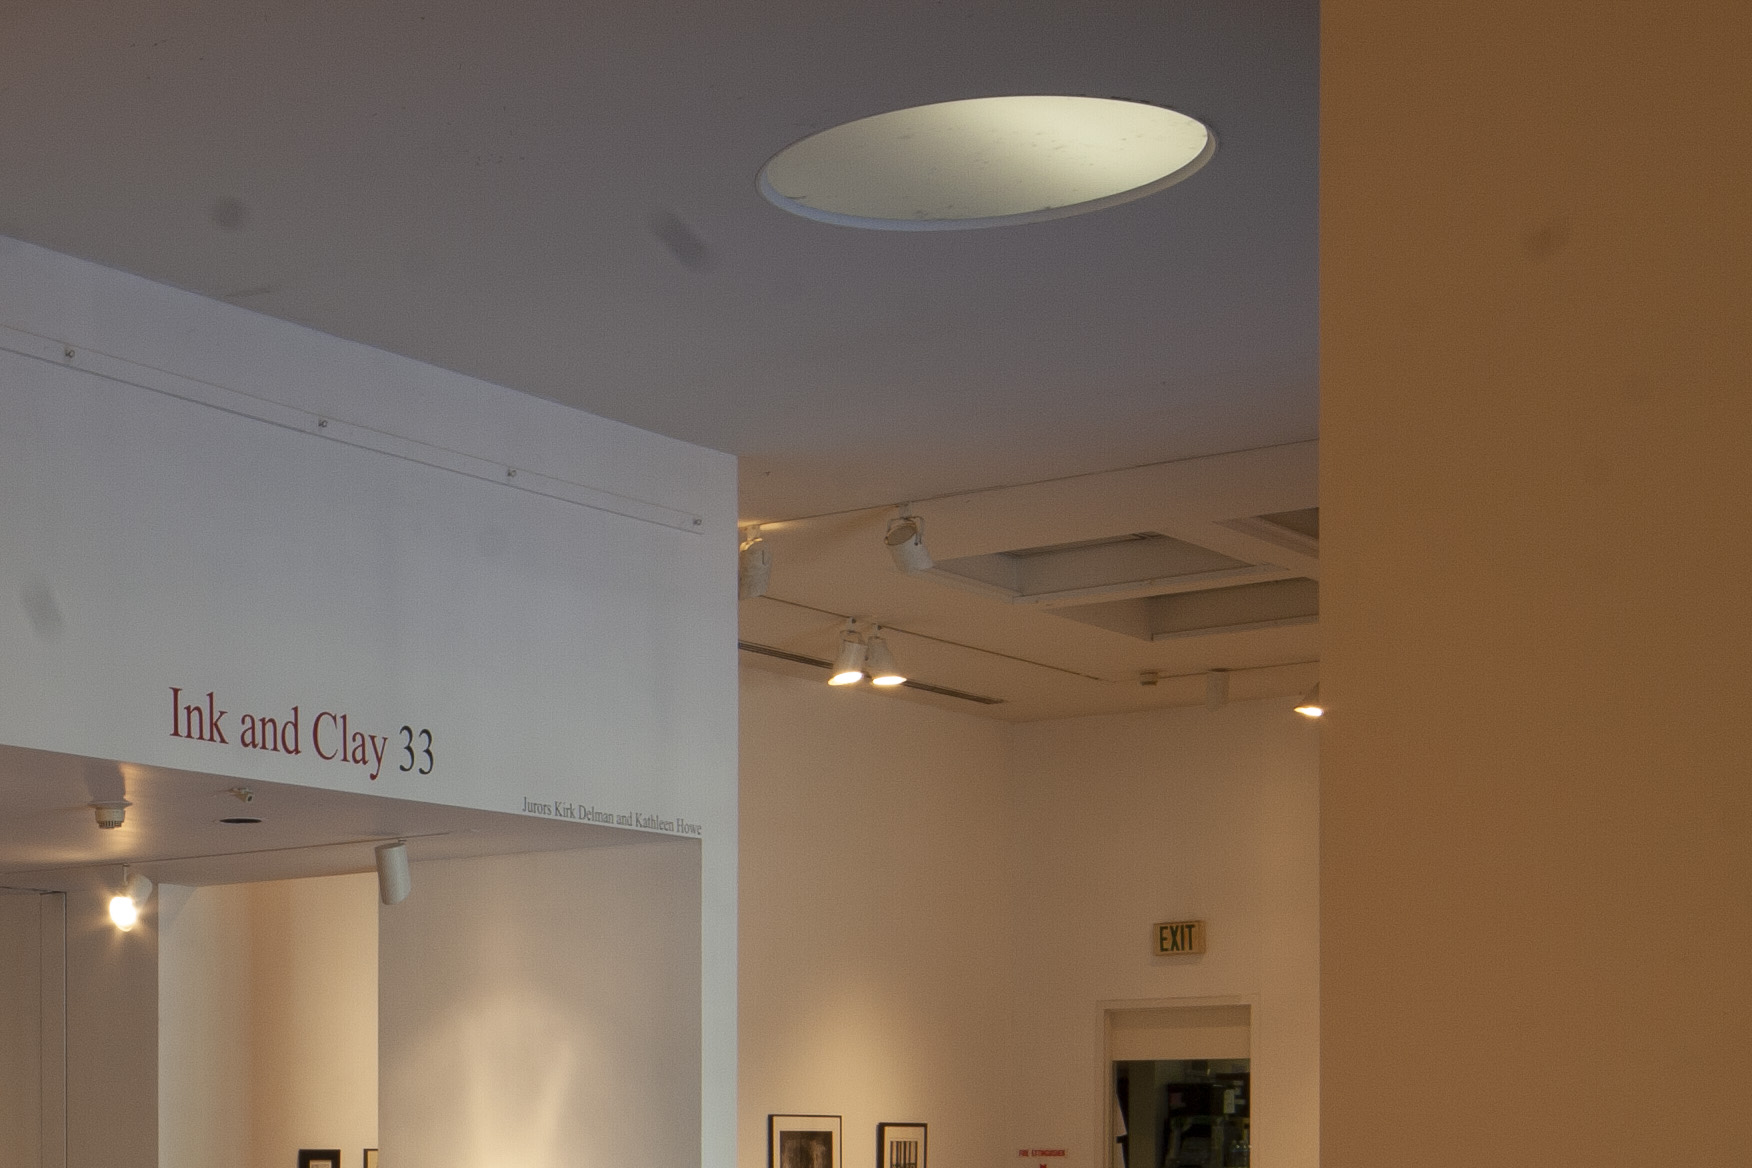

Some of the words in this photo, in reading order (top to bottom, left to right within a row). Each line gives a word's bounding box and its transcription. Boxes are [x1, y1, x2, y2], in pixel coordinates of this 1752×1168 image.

[168, 686, 229, 744] Ink
[240, 705, 301, 755] and
[312, 711, 388, 780] Clay
[399, 725, 434, 775] 33
[522, 796, 552, 816] Jurors
[554, 801, 576, 819] Kirk
[578, 804, 614, 824] Delman
[616, 810, 633, 827] and
[635, 812, 675, 832] Kathleen
[676, 817, 702, 836] Howe
[1159, 924, 1196, 953] EXIT
